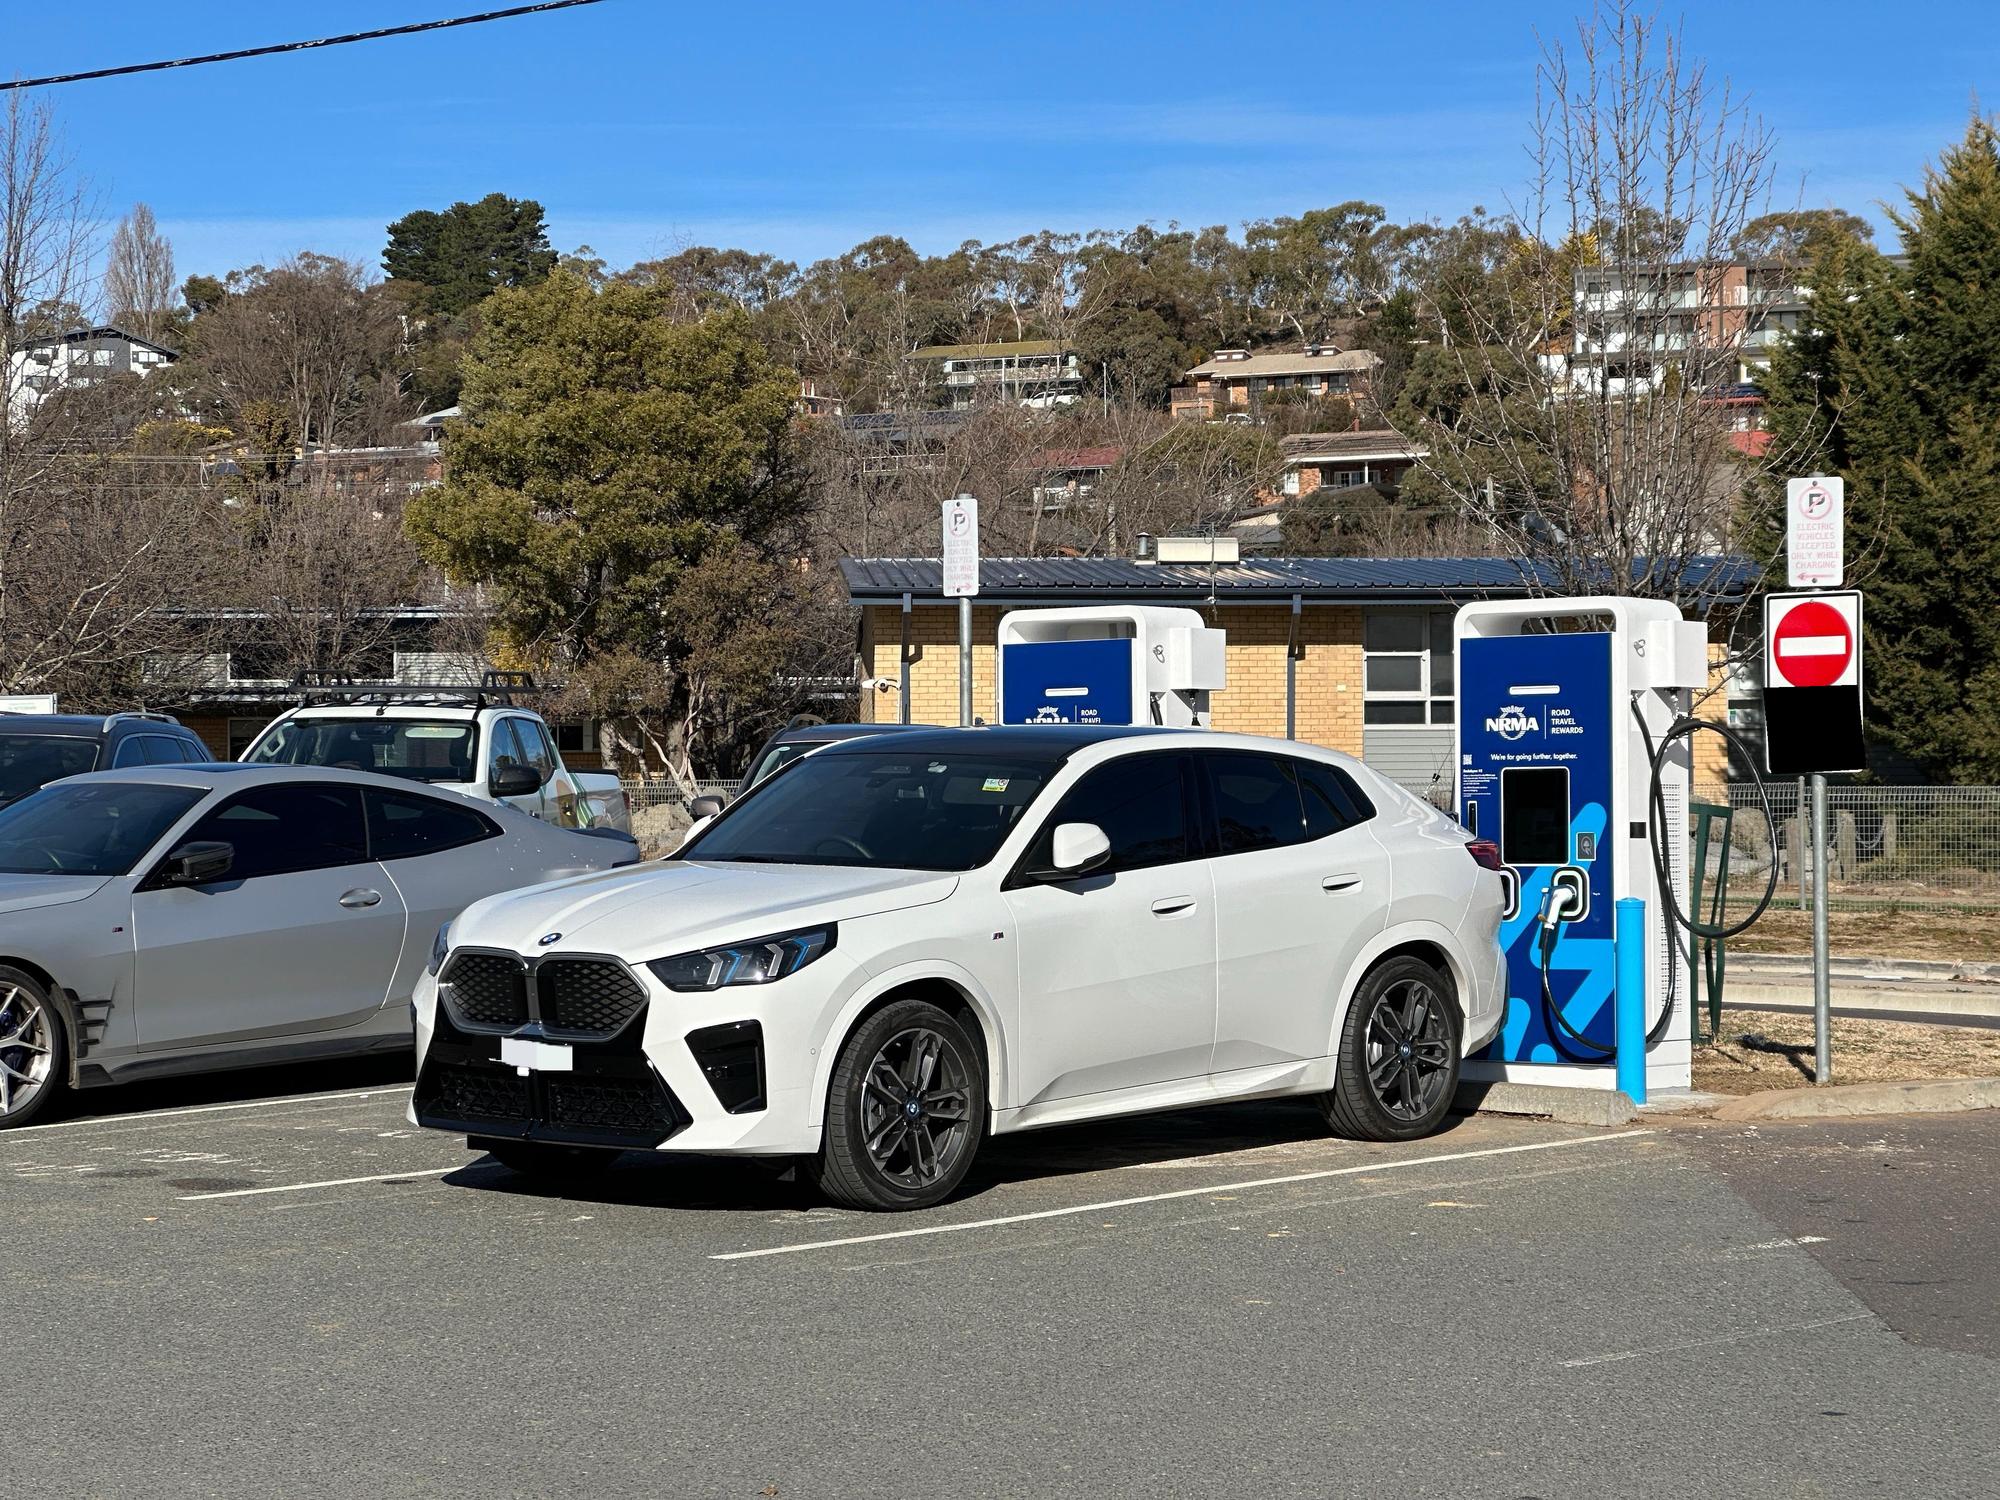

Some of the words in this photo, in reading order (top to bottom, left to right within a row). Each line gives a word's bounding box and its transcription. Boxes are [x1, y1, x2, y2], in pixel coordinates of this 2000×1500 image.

[1796, 522, 1835, 530] ELECTRIC
[1795, 561, 1837, 569] CHARGING
[1486, 717, 1539, 732] NRMA
[1551, 726, 1584, 734] REWARDS
[1490, 753, 1506, 761] We're
[1515, 753, 1532, 762] going
[1532, 752, 1553, 761] further,
[1553, 752, 1578, 761] together.
